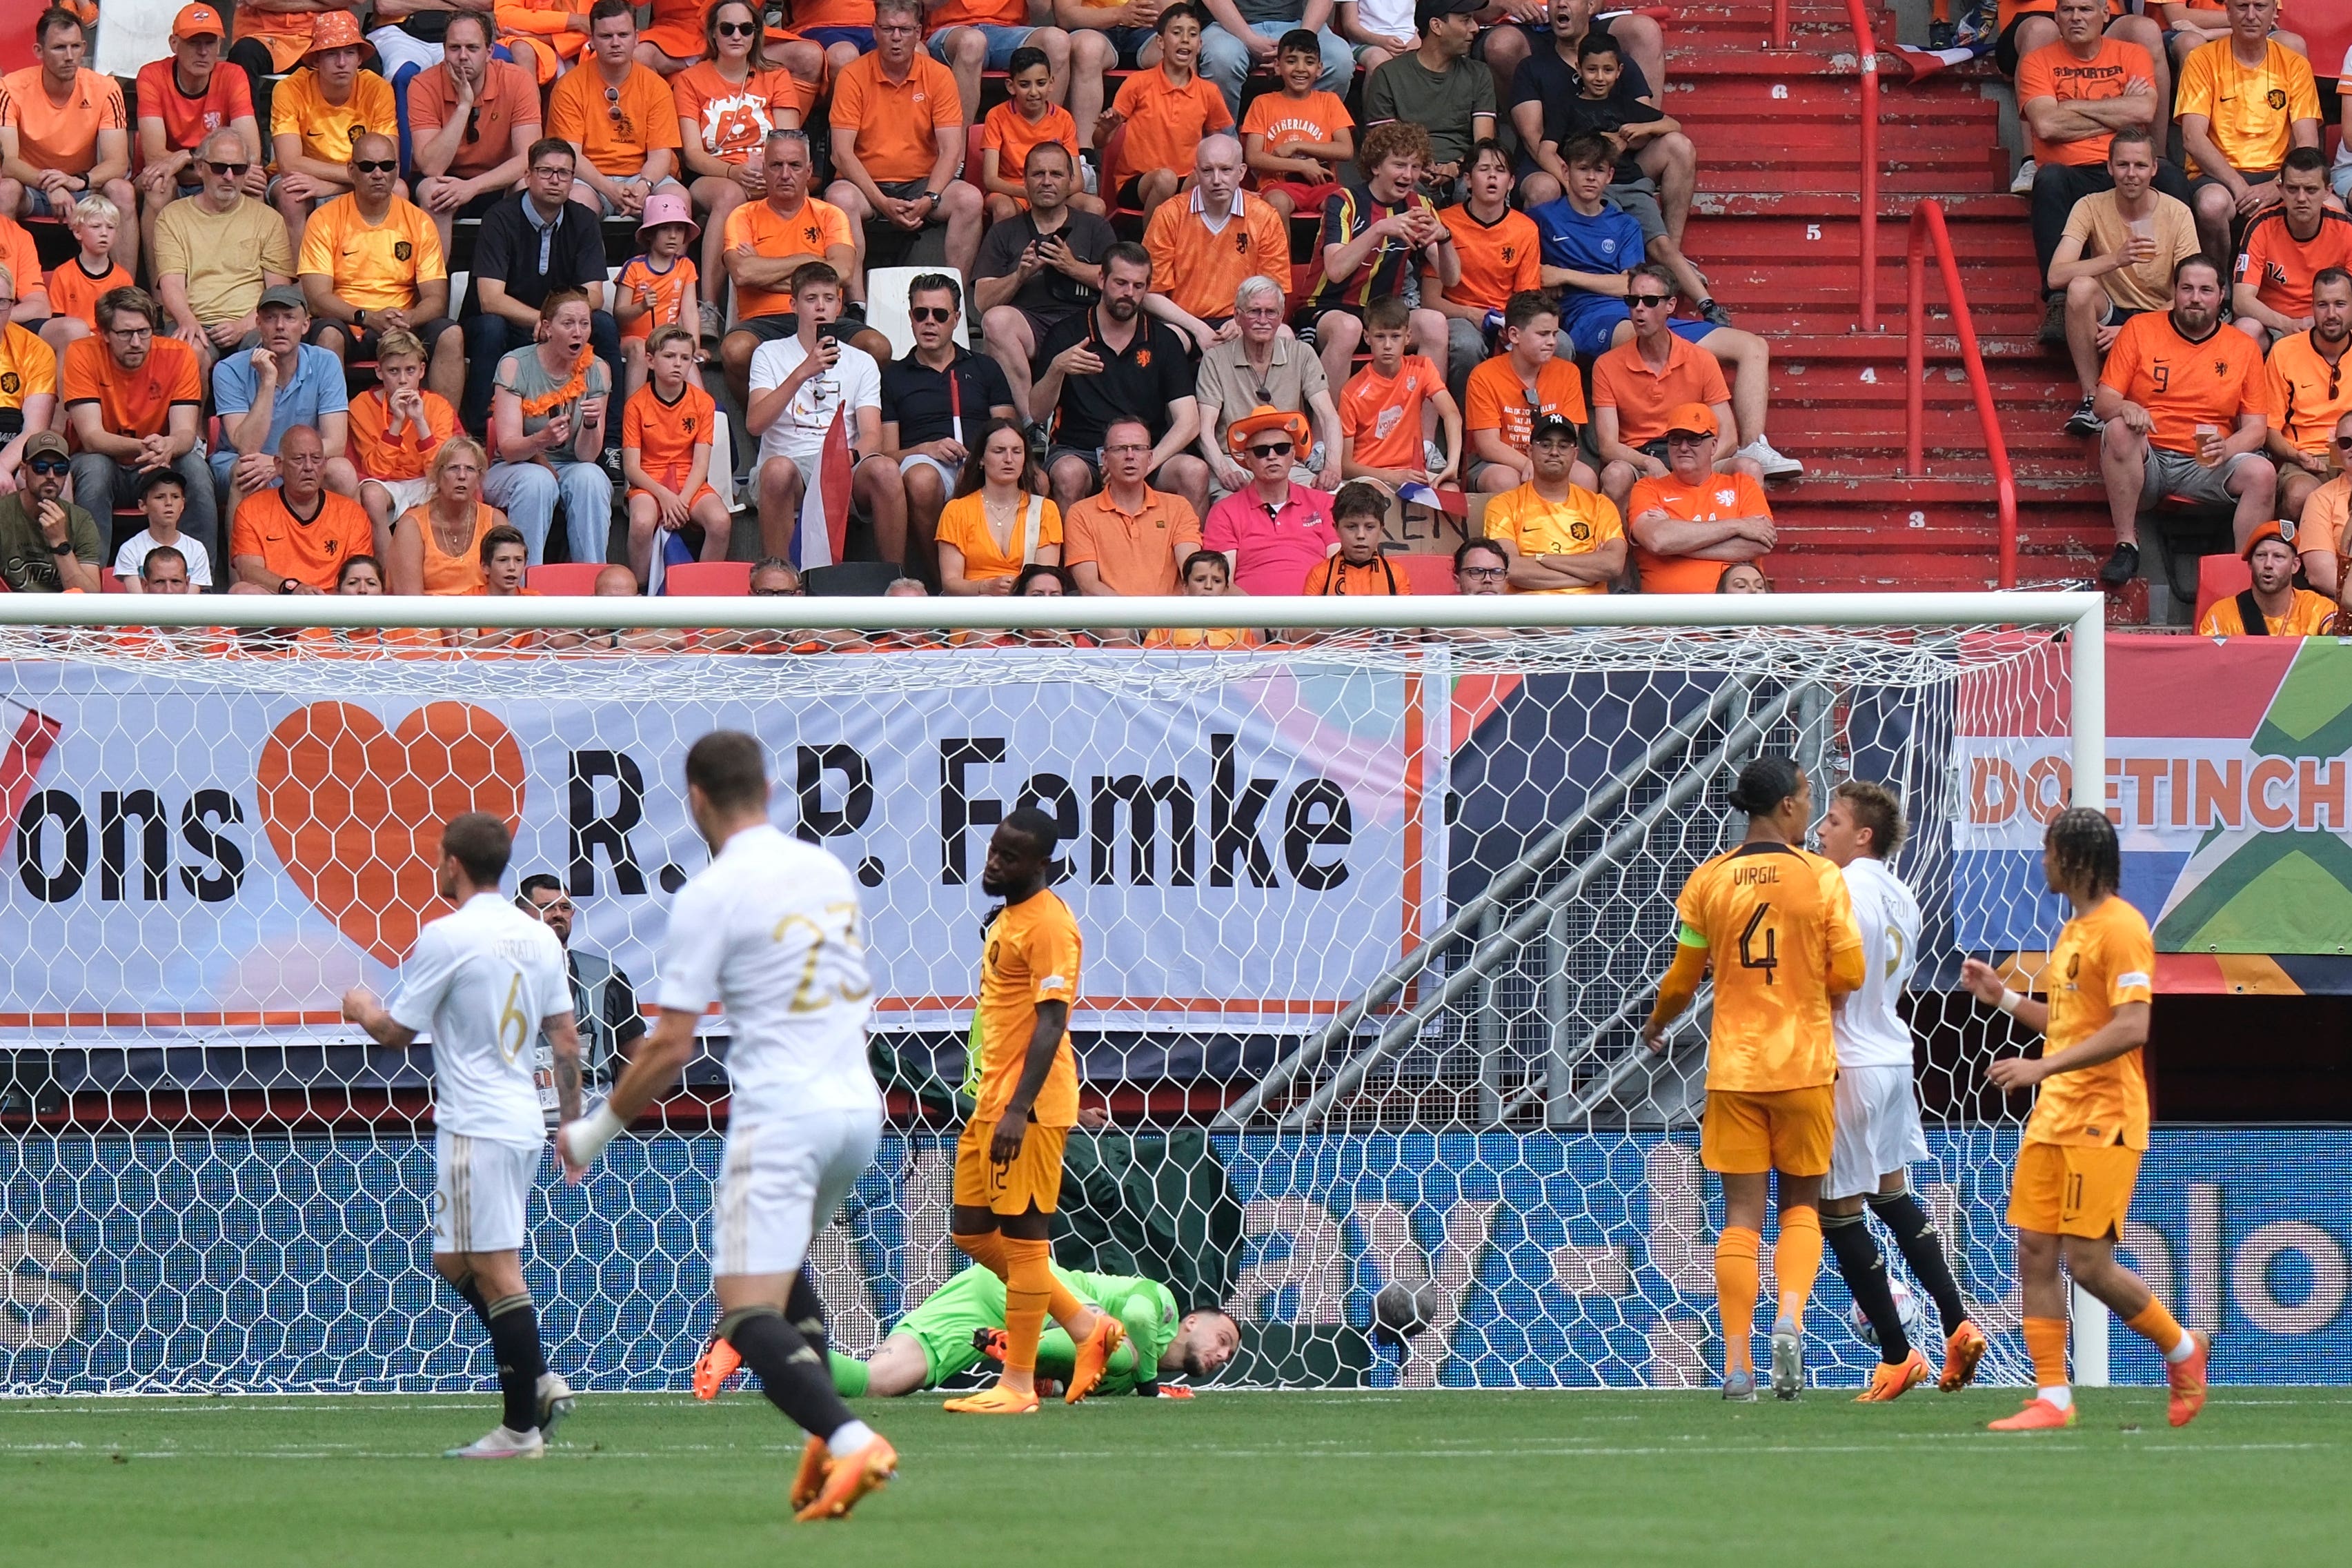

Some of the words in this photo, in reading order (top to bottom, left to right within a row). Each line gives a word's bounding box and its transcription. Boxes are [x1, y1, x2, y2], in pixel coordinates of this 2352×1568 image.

[2053, 66, 2124, 79] SUPPORTER
[1267, 119, 1323, 141] NETHERLANDS
[1806, 224, 1821, 241] 5
[2266, 261, 2287, 284] 14
[1859, 367, 1877, 384] 4
[2152, 366, 2169, 393] 9
[1909, 511, 1925, 527] 3
[1968, 756, 2347, 829] DOETINCH
[17, 789, 245, 903] ons
[940, 733, 1353, 891] Femke
[1734, 865, 1780, 886] VIRGIL
[772, 902, 872, 1013] 23
[1739, 902, 1777, 986] 4
[498, 971, 528, 1067] 6
[990, 1160, 1010, 1191] 12
[2066, 1173, 2082, 1210] 11
